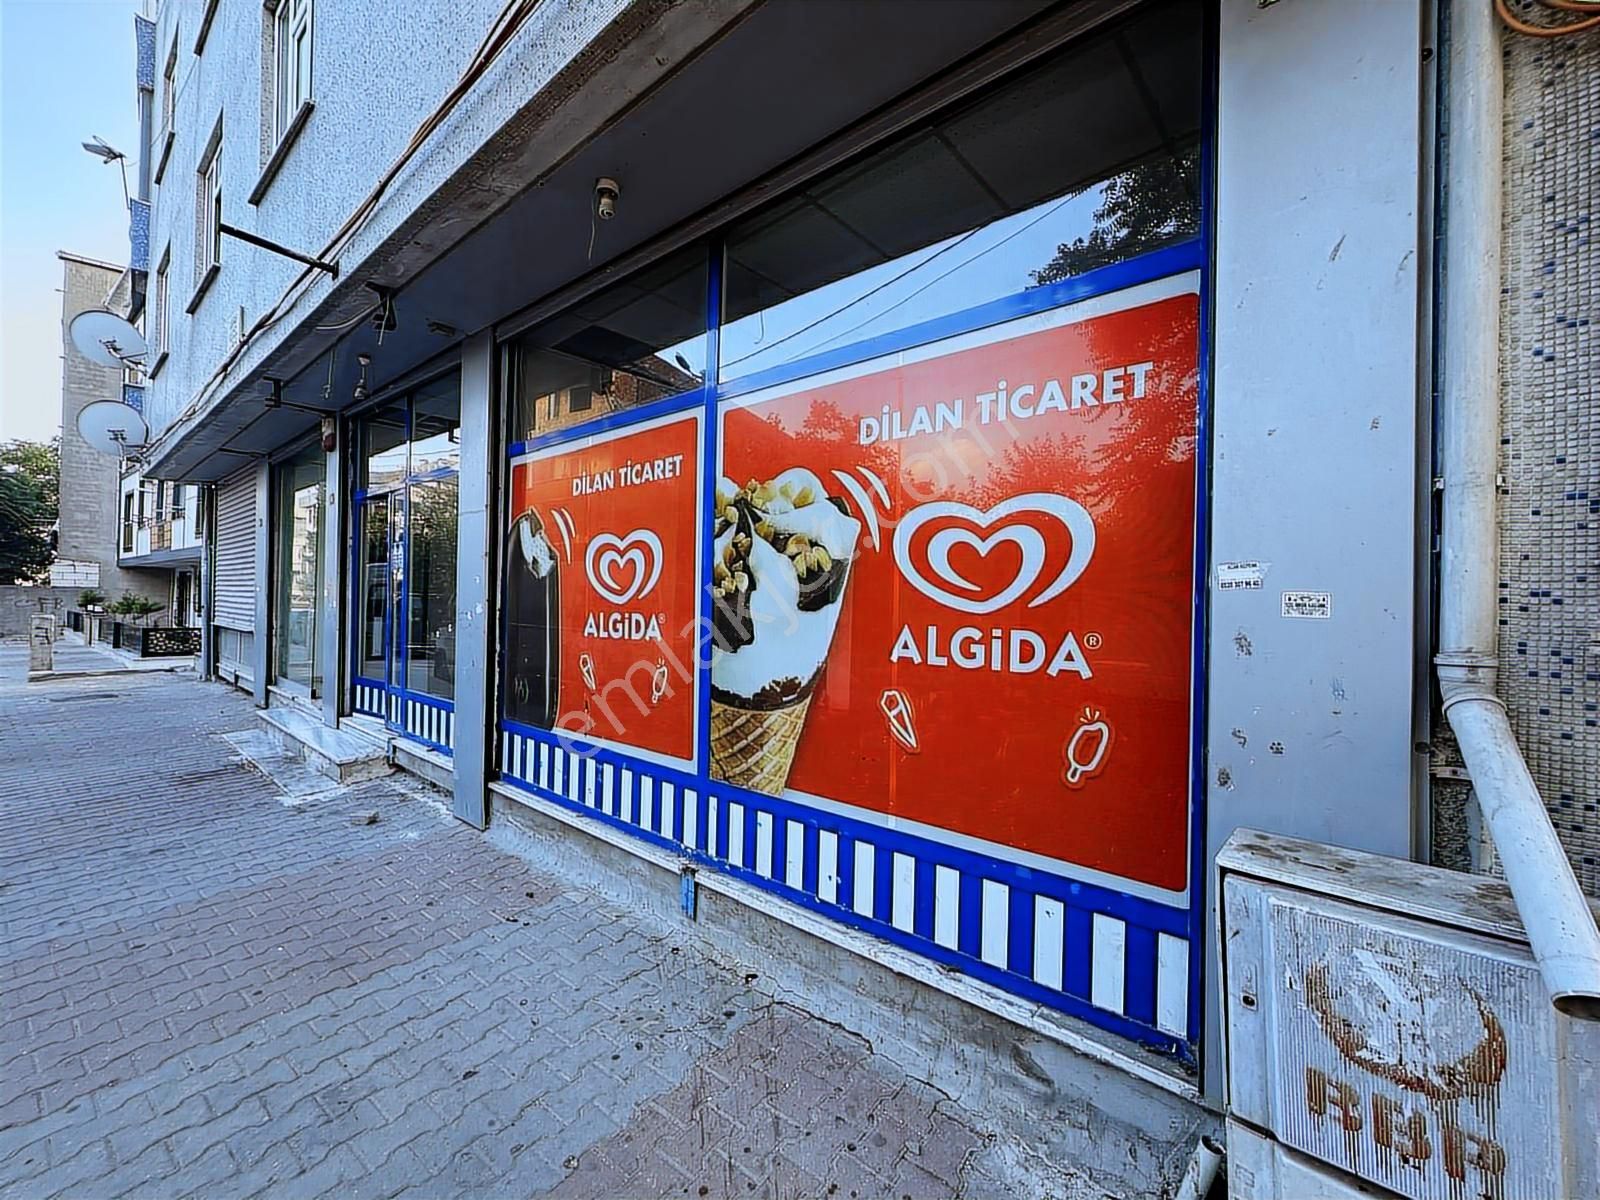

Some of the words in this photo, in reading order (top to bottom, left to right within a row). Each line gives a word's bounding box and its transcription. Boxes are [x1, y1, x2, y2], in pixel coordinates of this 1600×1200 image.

[859, 398, 964, 446] DİLAN
[975, 361, 1154, 425] TİCARET
[572, 470, 615, 497] DİLAN
[618, 454, 683, 487] TİCARET
